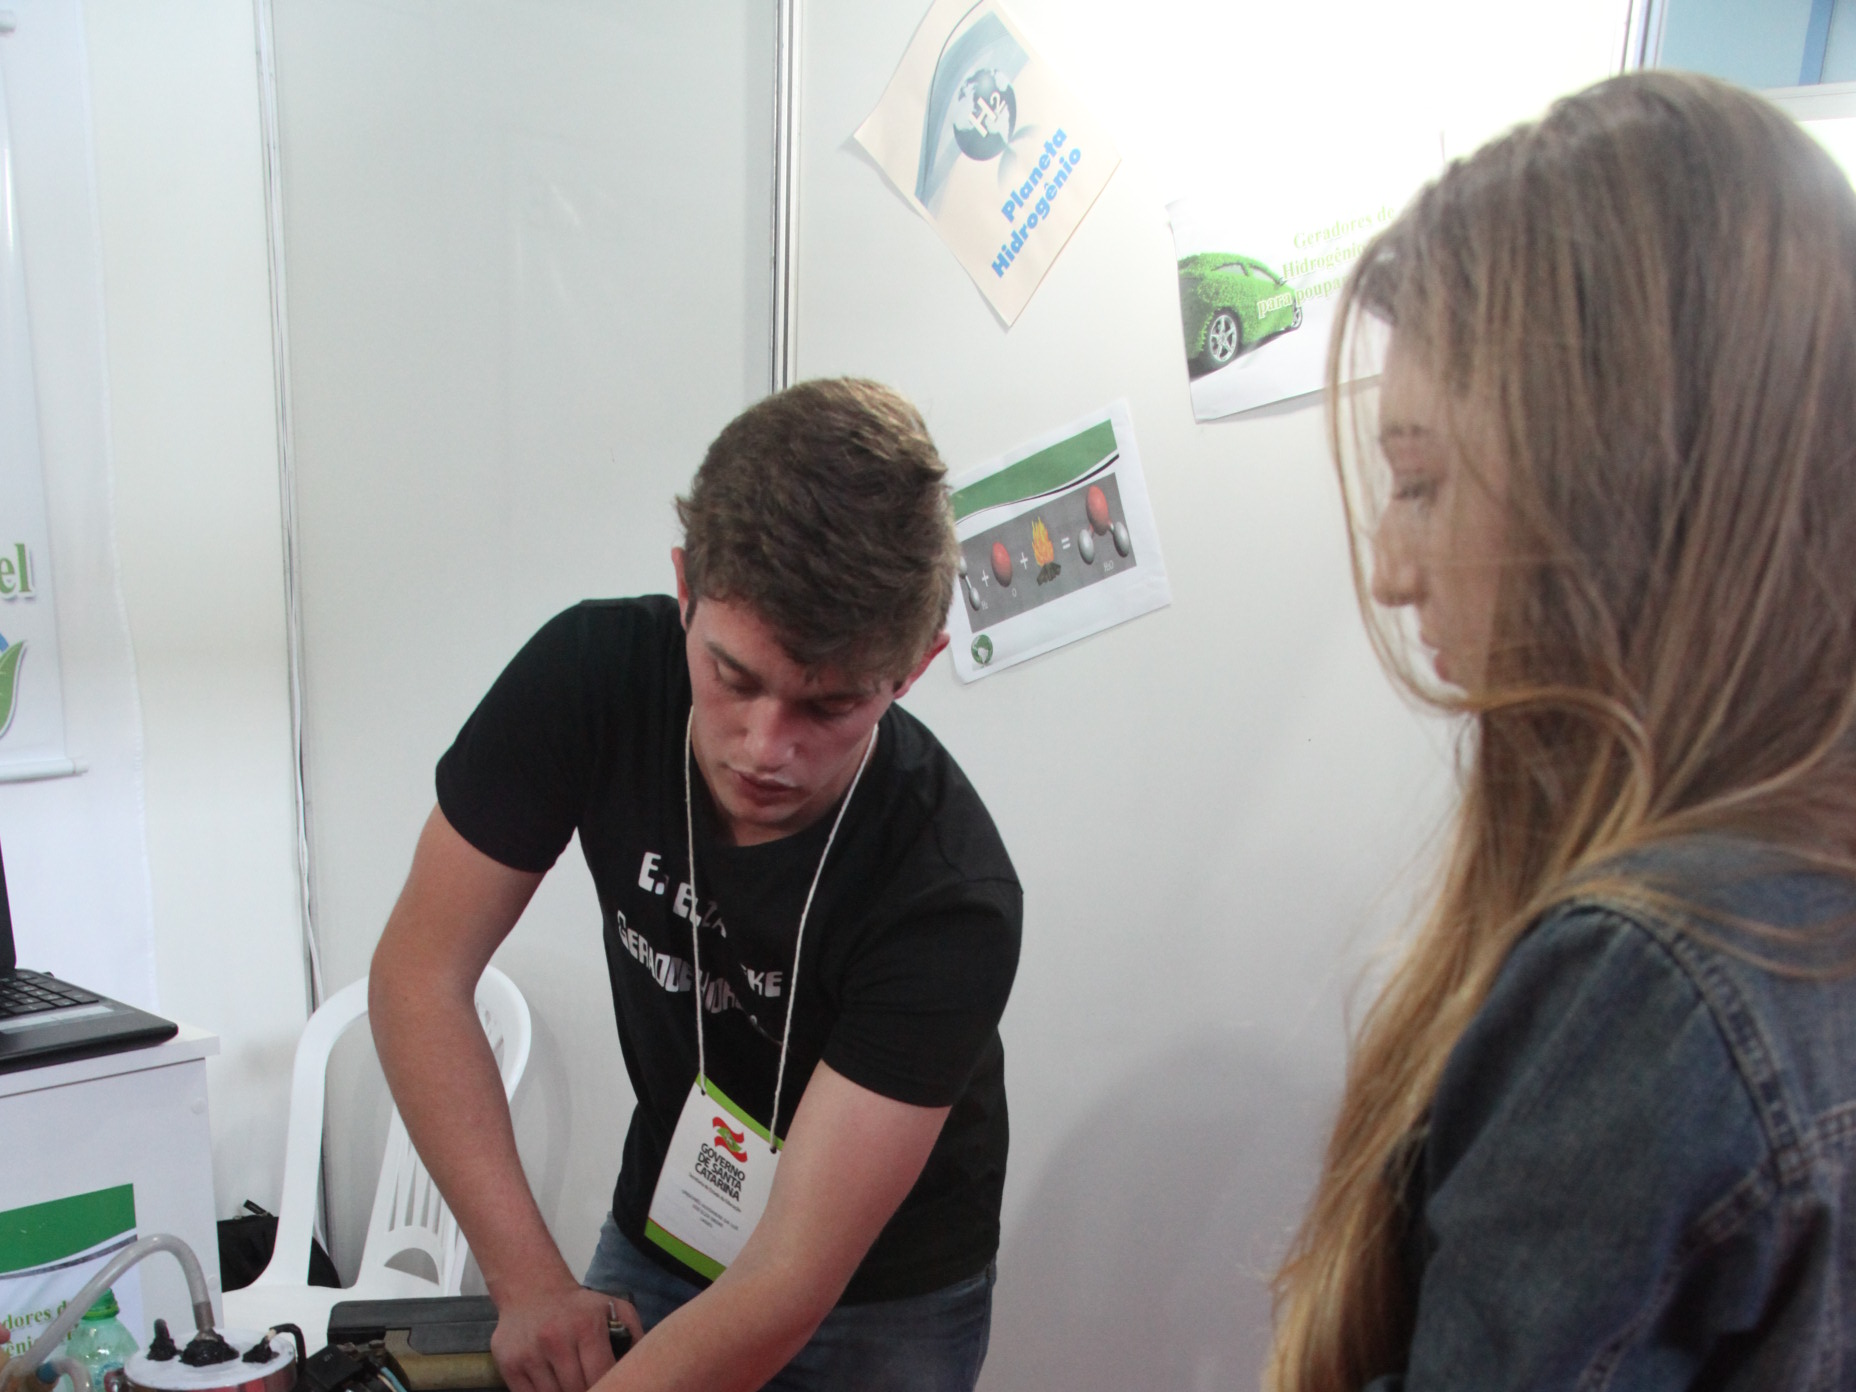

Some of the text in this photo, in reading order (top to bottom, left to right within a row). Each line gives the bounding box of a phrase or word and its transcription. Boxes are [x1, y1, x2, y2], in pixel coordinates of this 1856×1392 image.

[1001, 128, 1067, 223] Planeta
[991, 148, 1082, 278] Hidrogênio
[1293, 205, 1396, 249] Geradores de
[1257, 292, 1292, 319] para
[694, 1162, 740, 1202] CATARINA
[697, 1150, 742, 1192] DE SANTA
[701, 1142, 746, 1182] GOVERNO
